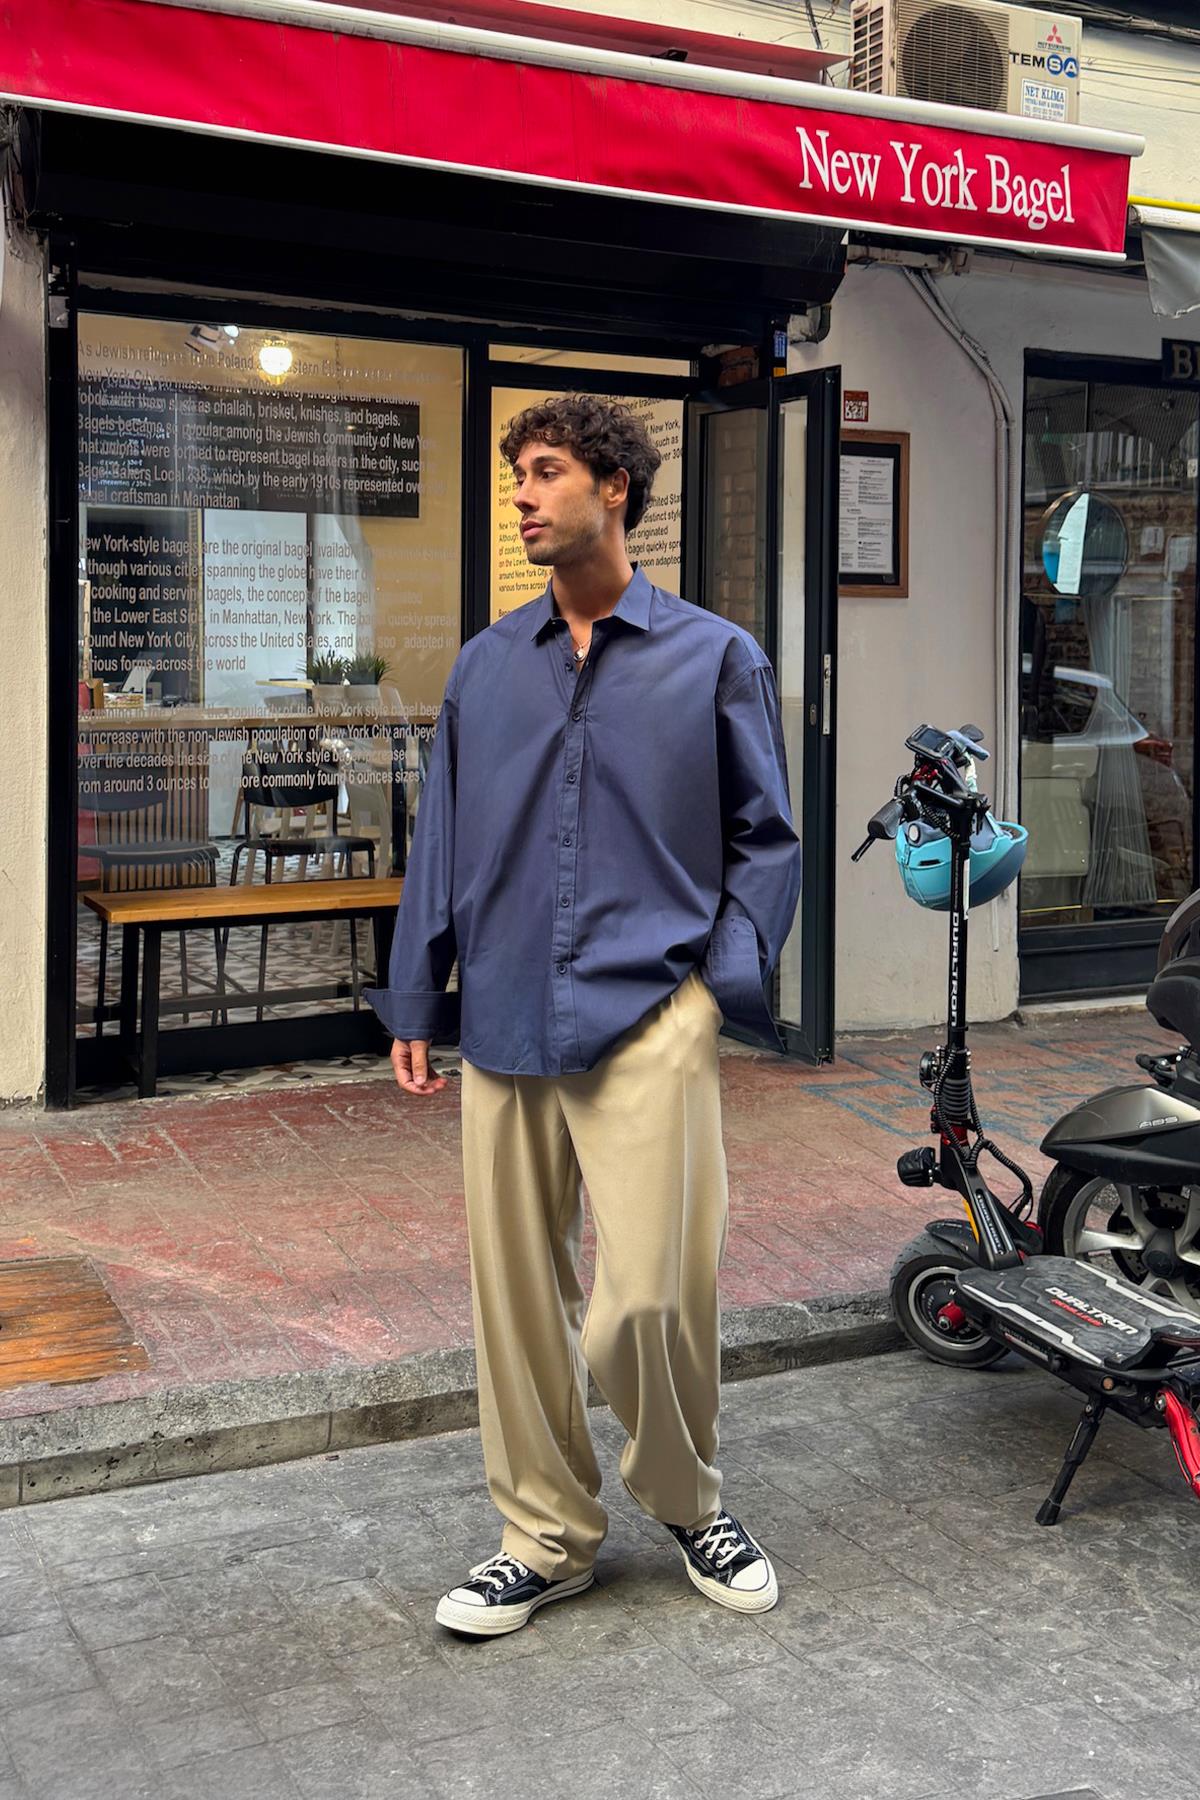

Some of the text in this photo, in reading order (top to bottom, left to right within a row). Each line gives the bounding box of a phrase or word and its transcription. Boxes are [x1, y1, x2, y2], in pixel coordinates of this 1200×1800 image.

[1009, 52, 1079, 78] TEMSA
[1025, 85, 1040, 98] NET
[795, 126, 1075, 230] New York Bagel
[95, 343, 135, 360] Jewish
[1170, 344, 1200, 381] B
[212, 400, 256, 420] challah,
[258, 402, 298, 423] brisket,
[300, 405, 342, 426] knishes,
[344, 408, 363, 424] and
[365, 409, 401, 429] bagels.
[224, 426, 263, 445] among
[265, 425, 282, 442] the
[284, 427, 320, 444] Jewish
[322, 430, 378, 451] community
[379, 432, 391, 448] of
[392, 433, 416, 450] New
[214, 445, 225, 461] to
[227, 446, 280, 466] represent
[281, 449, 311, 469] bagel
[313, 450, 347, 468] bakers
[349, 453, 359, 469] in
[360, 453, 377, 470] the
[378, 454, 399, 474] city,
[212, 468, 246, 487] which
[247, 470, 260, 491] by
[262, 471, 280, 488] the
[281, 472, 308, 492] early
[310, 474, 341, 491] 1910s
[342, 476, 404, 496] represented
[110, 487, 240, 509] craftsman in Manhattan
[103, 534, 160, 557] York-style
[221, 539, 239, 556] the
[240, 540, 282, 560] original
[284, 540, 312, 561] bagel
[130, 559, 172, 577] various
[206, 562, 256, 582] spanning
[257, 563, 276, 579] the
[277, 563, 307, 583] globe
[334, 564, 359, 581] their
[91, 583, 136, 605] cooking
[138, 584, 160, 601] and
[206, 584, 245, 606] bagels,
[247, 586, 265, 603] the
[324, 587, 341, 603] the
[342, 588, 372, 607] bagel
[92, 607, 112, 624] the
[113, 608, 150, 625] Lower
[151, 608, 178, 625] East
[209, 608, 219, 625] in
[222, 609, 282, 628] Manhattan,
[283, 609, 307, 626] New
[337, 609, 356, 626] The
[118, 631, 144, 649] New
[146, 631, 171, 649] York
[203, 635, 239, 650] across
[240, 632, 258, 649] the
[259, 631, 295, 650] United
[333, 632, 353, 649] and
[155, 658, 192, 672] across
[215, 655, 247, 672] world
[315, 703, 339, 719] New
[340, 702, 363, 718] York
[89, 723, 412, 746] increase with the non-Jewish population of New York City and
[104, 752, 124, 769] the
[125, 751, 175, 769] decades
[176, 750, 195, 767] the
[253, 749, 278, 766] New
[279, 749, 304, 765] York
[305, 747, 330, 768] style
[103, 774, 144, 793] around
[146, 774, 154, 792] 3
[155, 776, 196, 792] ounces
[260, 770, 314, 791] commonly
[316, 768, 346, 786] found
[356, 770, 393, 785] ounces
[394, 768, 420, 783] sizes
[1045, 1286, 1139, 1335] DUALTRON
